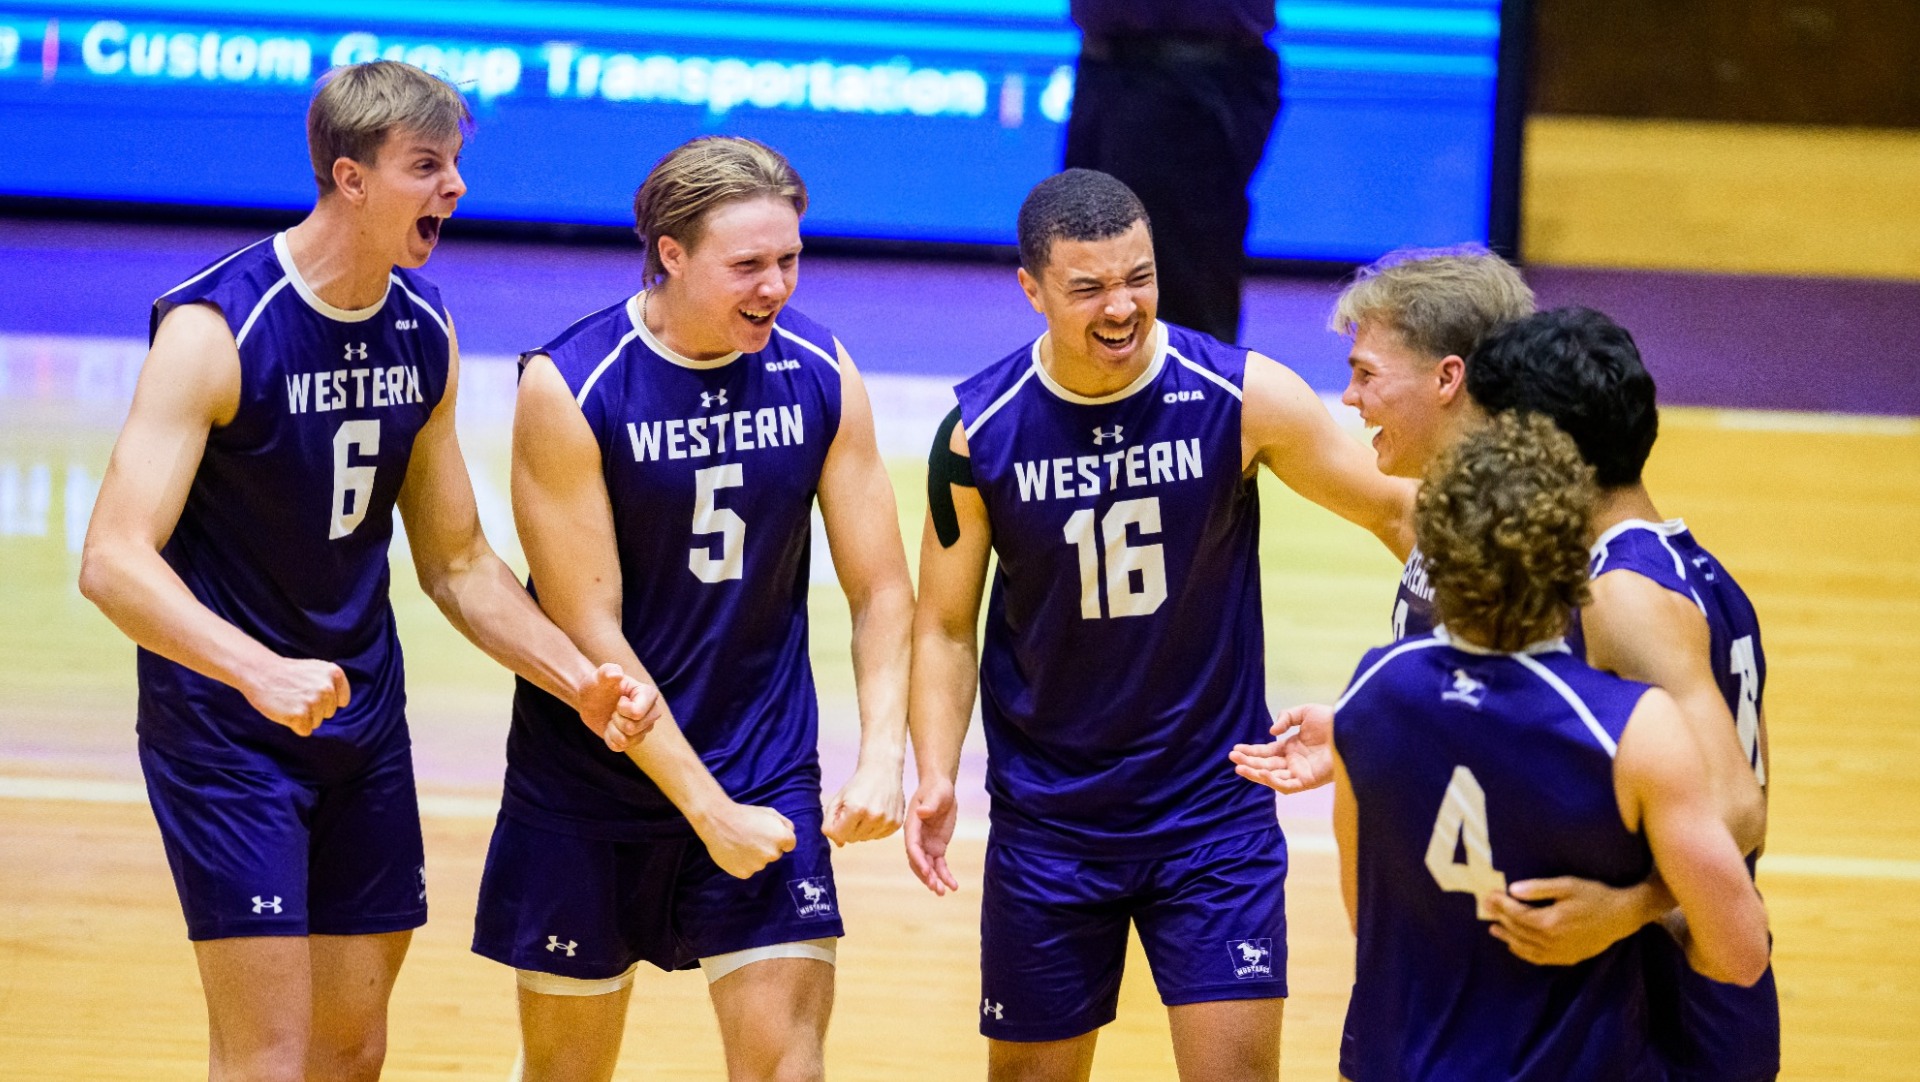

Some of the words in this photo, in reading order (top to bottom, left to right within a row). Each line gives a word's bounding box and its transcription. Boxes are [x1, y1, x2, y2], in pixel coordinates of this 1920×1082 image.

[82, 20, 311, 80] Custom
[544, 41, 986, 116] Transportation
[286, 366, 423, 414] WESTERN
[627, 404, 804, 462] WESTERN
[1163, 390, 1205, 404] OUA
[329, 419, 380, 540] 6
[1014, 438, 1203, 502] WESTERN
[688, 463, 746, 583] 5
[1063, 497, 1168, 620] 16
[1425, 765, 1507, 920] 4
